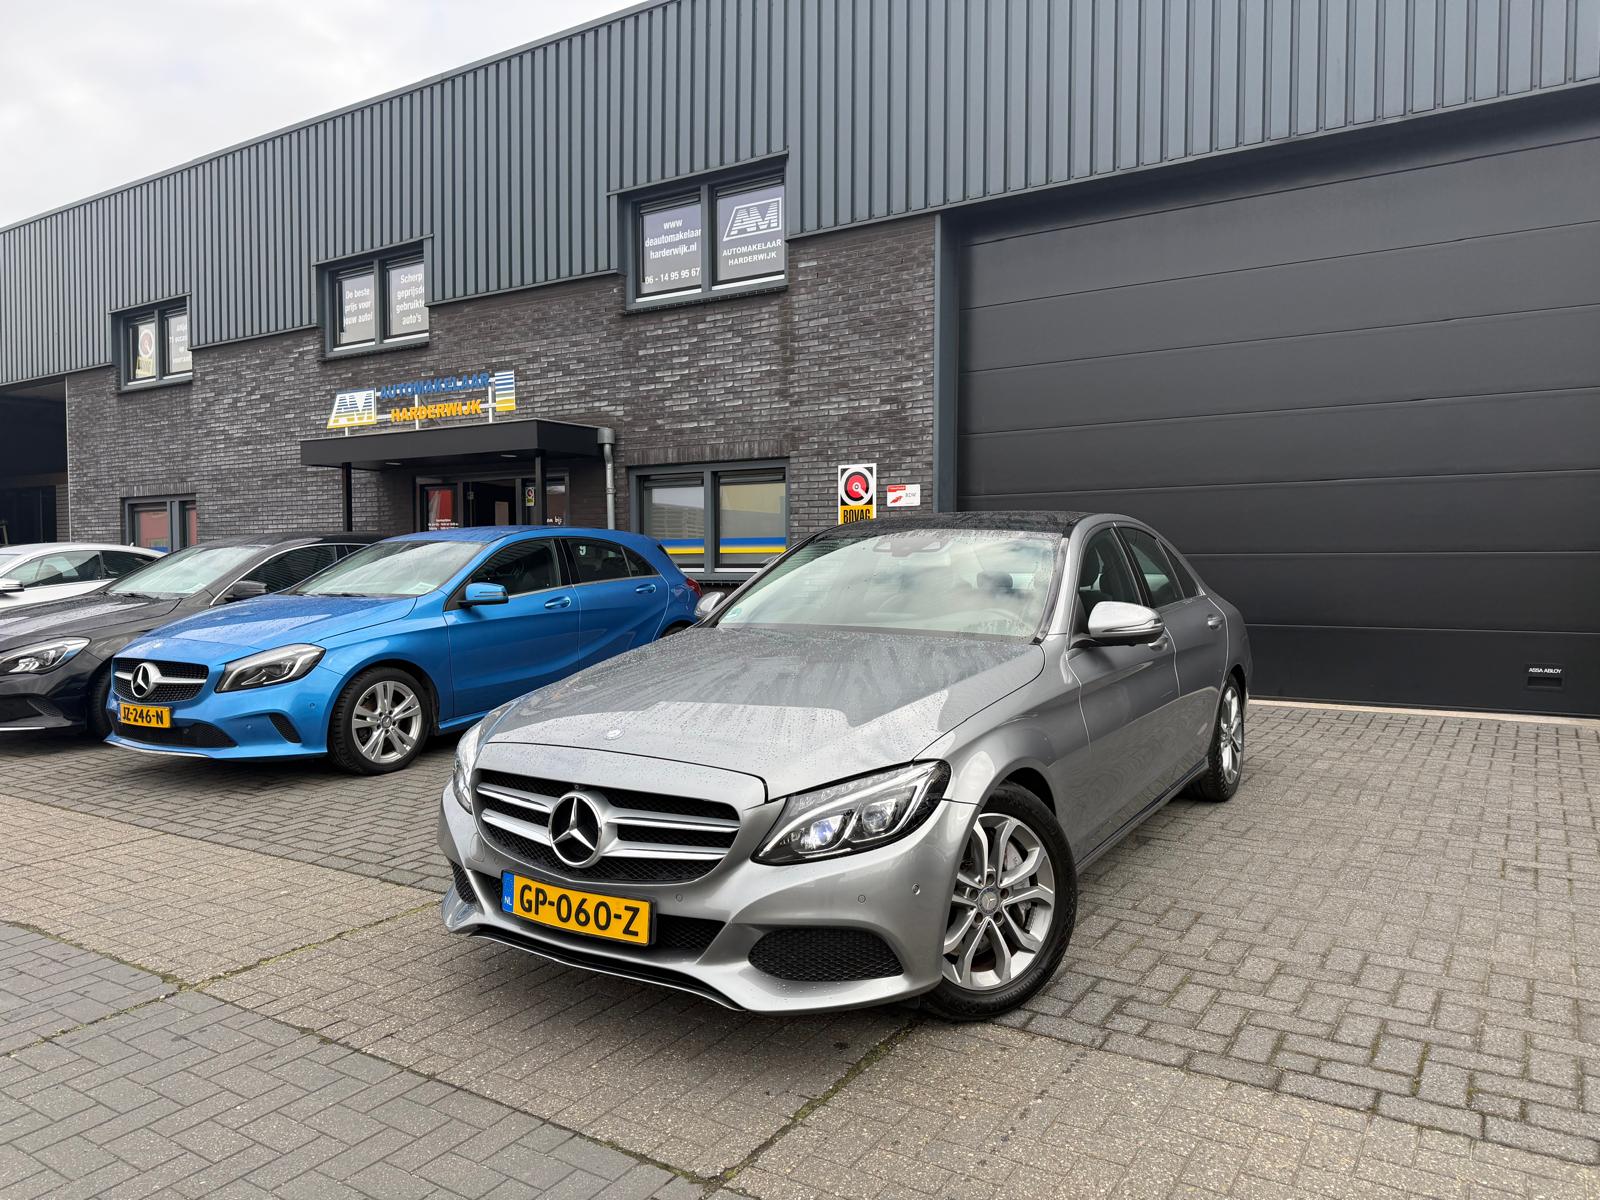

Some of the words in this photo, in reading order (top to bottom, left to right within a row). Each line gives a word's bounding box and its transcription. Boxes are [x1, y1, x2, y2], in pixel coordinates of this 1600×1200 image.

[663, 218, 683, 230] www
[645, 228, 701, 247] deautomakelaar
[650, 242, 697, 260] harderwijk.nl
[722, 239, 782, 257] AUTOMAKELAAR
[728, 251, 777, 266] HARDERWIJK
[400, 273, 423, 284] Scherp
[645, 275, 654, 285] 06
[660, 272, 669, 282] 14
[670, 271, 679, 281] 95
[681, 269, 690, 279] 95
[691, 268, 700, 277] 67
[380, 372, 490, 399] AUTOMAKELAAR
[391, 399, 481, 422] HARDERWIJK
[843, 508, 871, 524] BOVAG
[123, 706, 164, 725] JZ-246-N
[504, 895, 513, 906] NL
[519, 884, 641, 937] GP-060-Z
